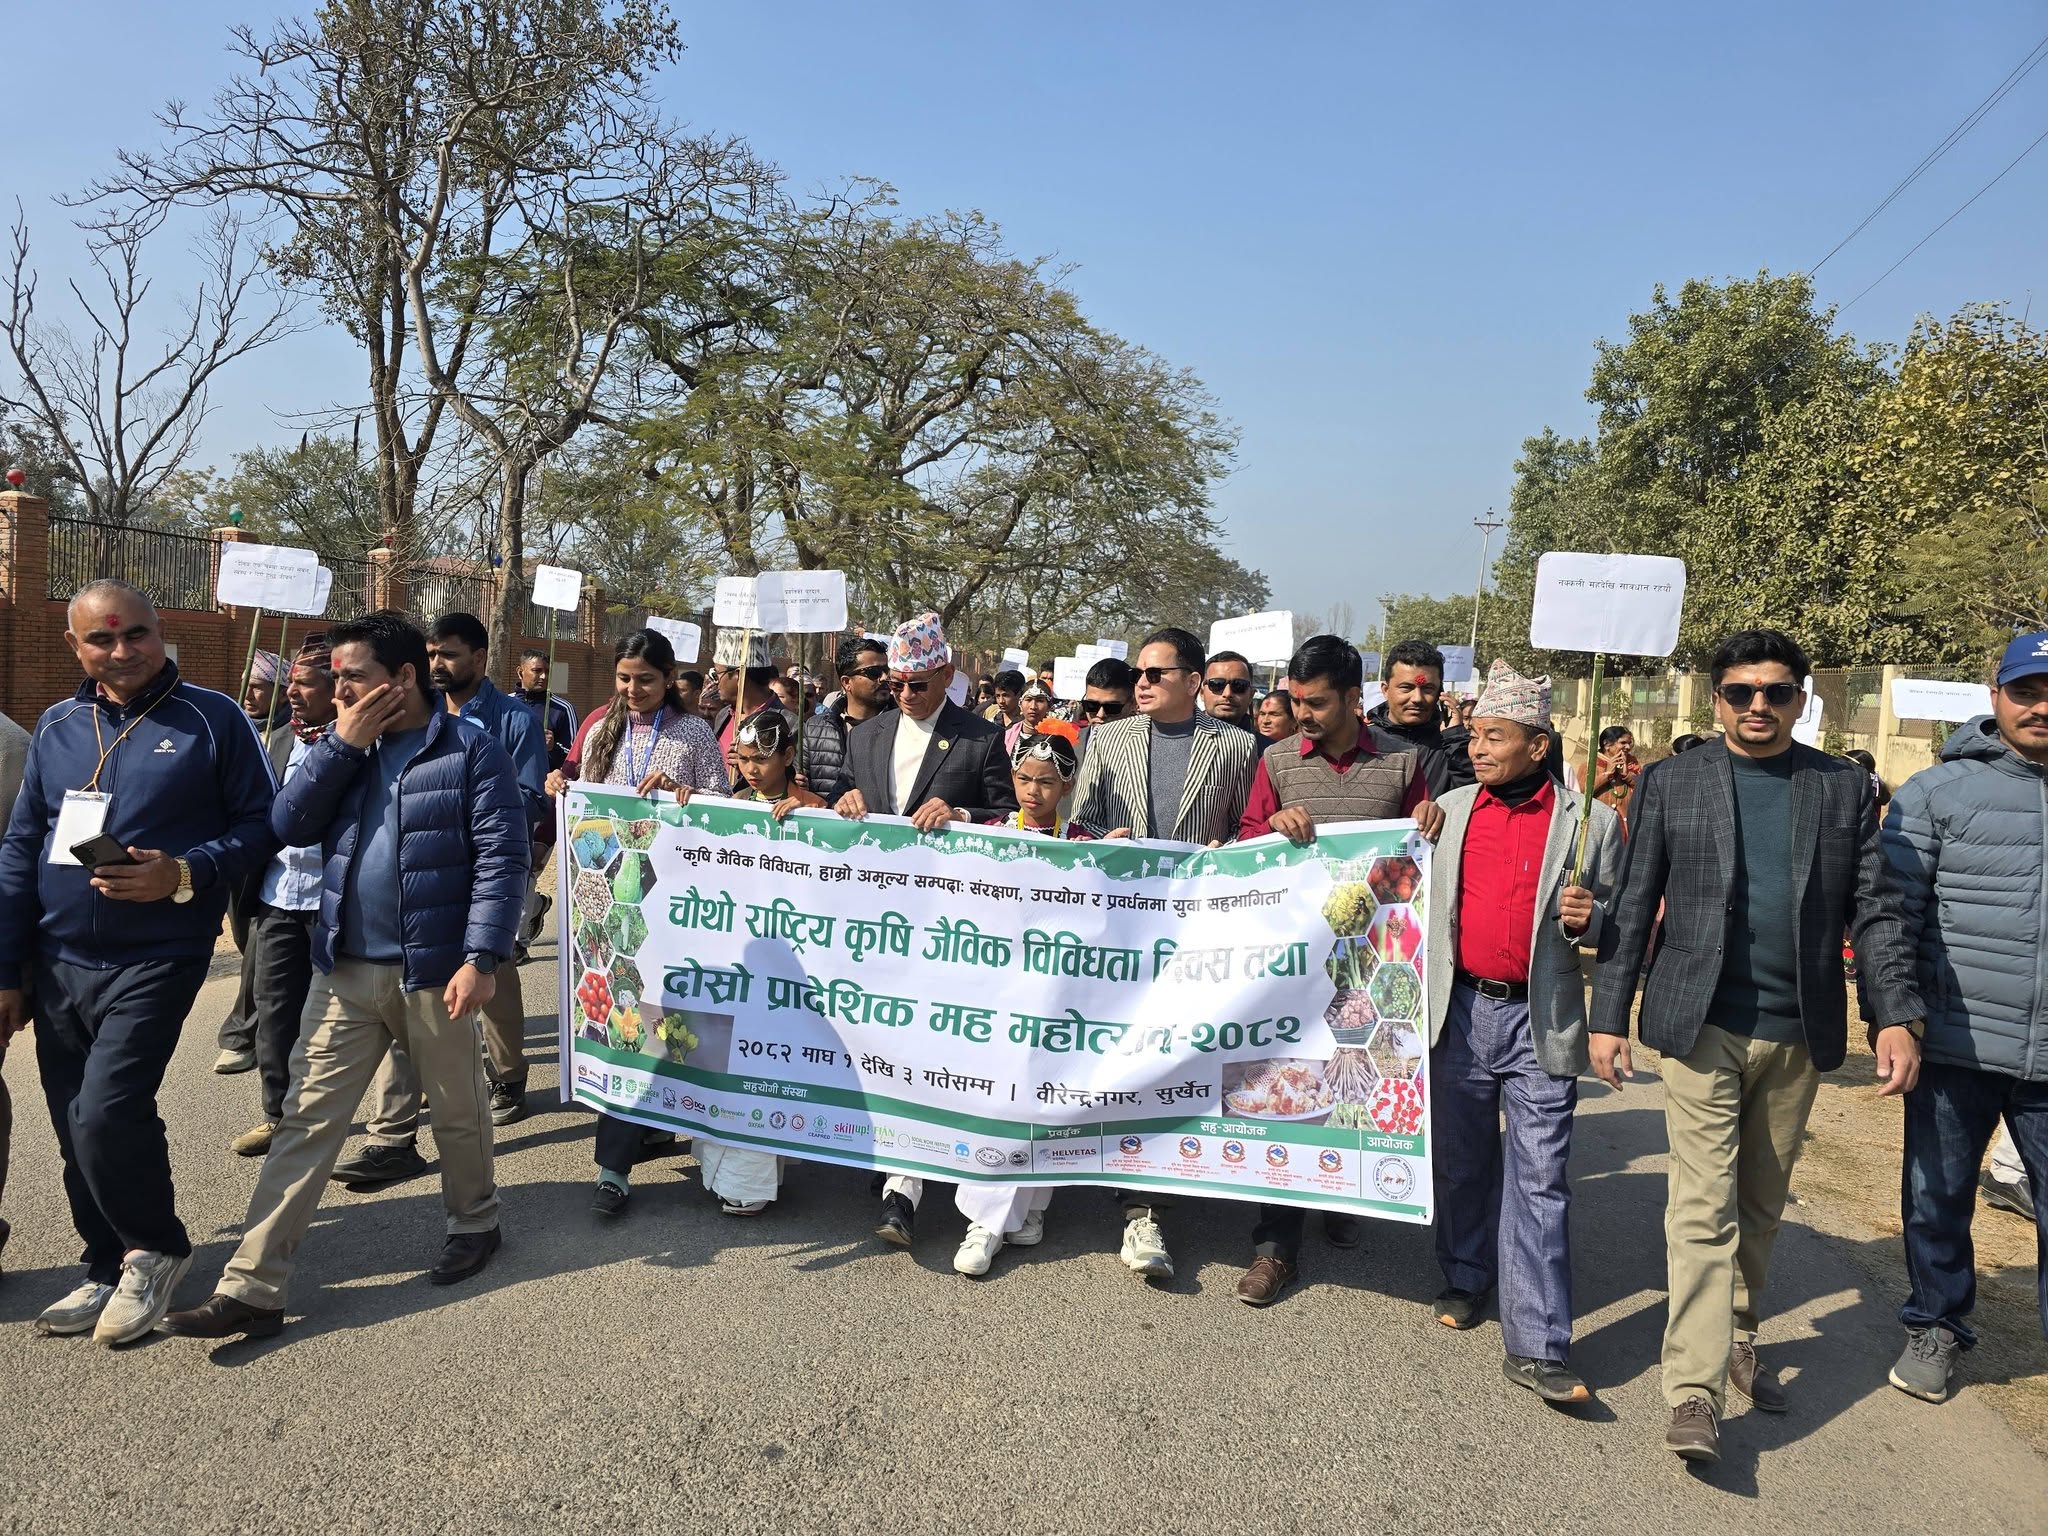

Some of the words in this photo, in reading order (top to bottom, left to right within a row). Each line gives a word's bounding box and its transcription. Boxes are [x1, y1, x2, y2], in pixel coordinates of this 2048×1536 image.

[1558, 578, 1585, 588] नक्कली
[1589, 579, 1616, 589] महदेखि
[1620, 583, 1649, 592] सावधान
[716, 847, 754, 868] जैविक
[759, 853, 813, 878] विविधता,
[818, 863, 852, 882] हाम्रो
[857, 868, 909, 890] अमूल्य
[969, 881, 1023, 902] संरक्षण,
[1030, 886, 1086, 906] उपयोग
[1091, 894, 1103, 908] र
[1106, 892, 1168, 912] प्रवर्धनमा
[1172, 899, 1201, 918] युवा
[668, 884, 737, 933] चौथो
[745, 897, 837, 955] राष्ट्रिय
[844, 910, 915, 962] कृषि
[922, 915, 1013, 968] जैविक
[1022, 928, 1143, 983] विविधता
[1243, 941, 1310, 981] तथा
[767, 974, 918, 1028] प्रादेशिक
[929, 1001, 998, 1043] मह
[738, 1039, 792, 1063] २०८२
[802, 1046, 836, 1066] माघ
[844, 1053, 852, 1069] १
[861, 1053, 895, 1078] देखि
[903, 1066, 913, 1086] ३
[923, 1067, 995, 1096] गतेसम्म
[1036, 1081, 1142, 1108] वीरेन्द्रनगर,
[1155, 1081, 1213, 1105] सुर्खेत
[743, 1080, 778, 1095] सहयोगी
[781, 1084, 808, 1098] संस्था
[694, 1101, 706, 1111] DCA
[720, 1107, 746, 1117] Renewable
[748, 1121, 765, 1129] OXFAM
[1200, 1120, 1267, 1137] सह-आयोजक
[1367, 1135, 1415, 1150] आयोजक
[1052, 1148, 1097, 1157] HELVETAS
